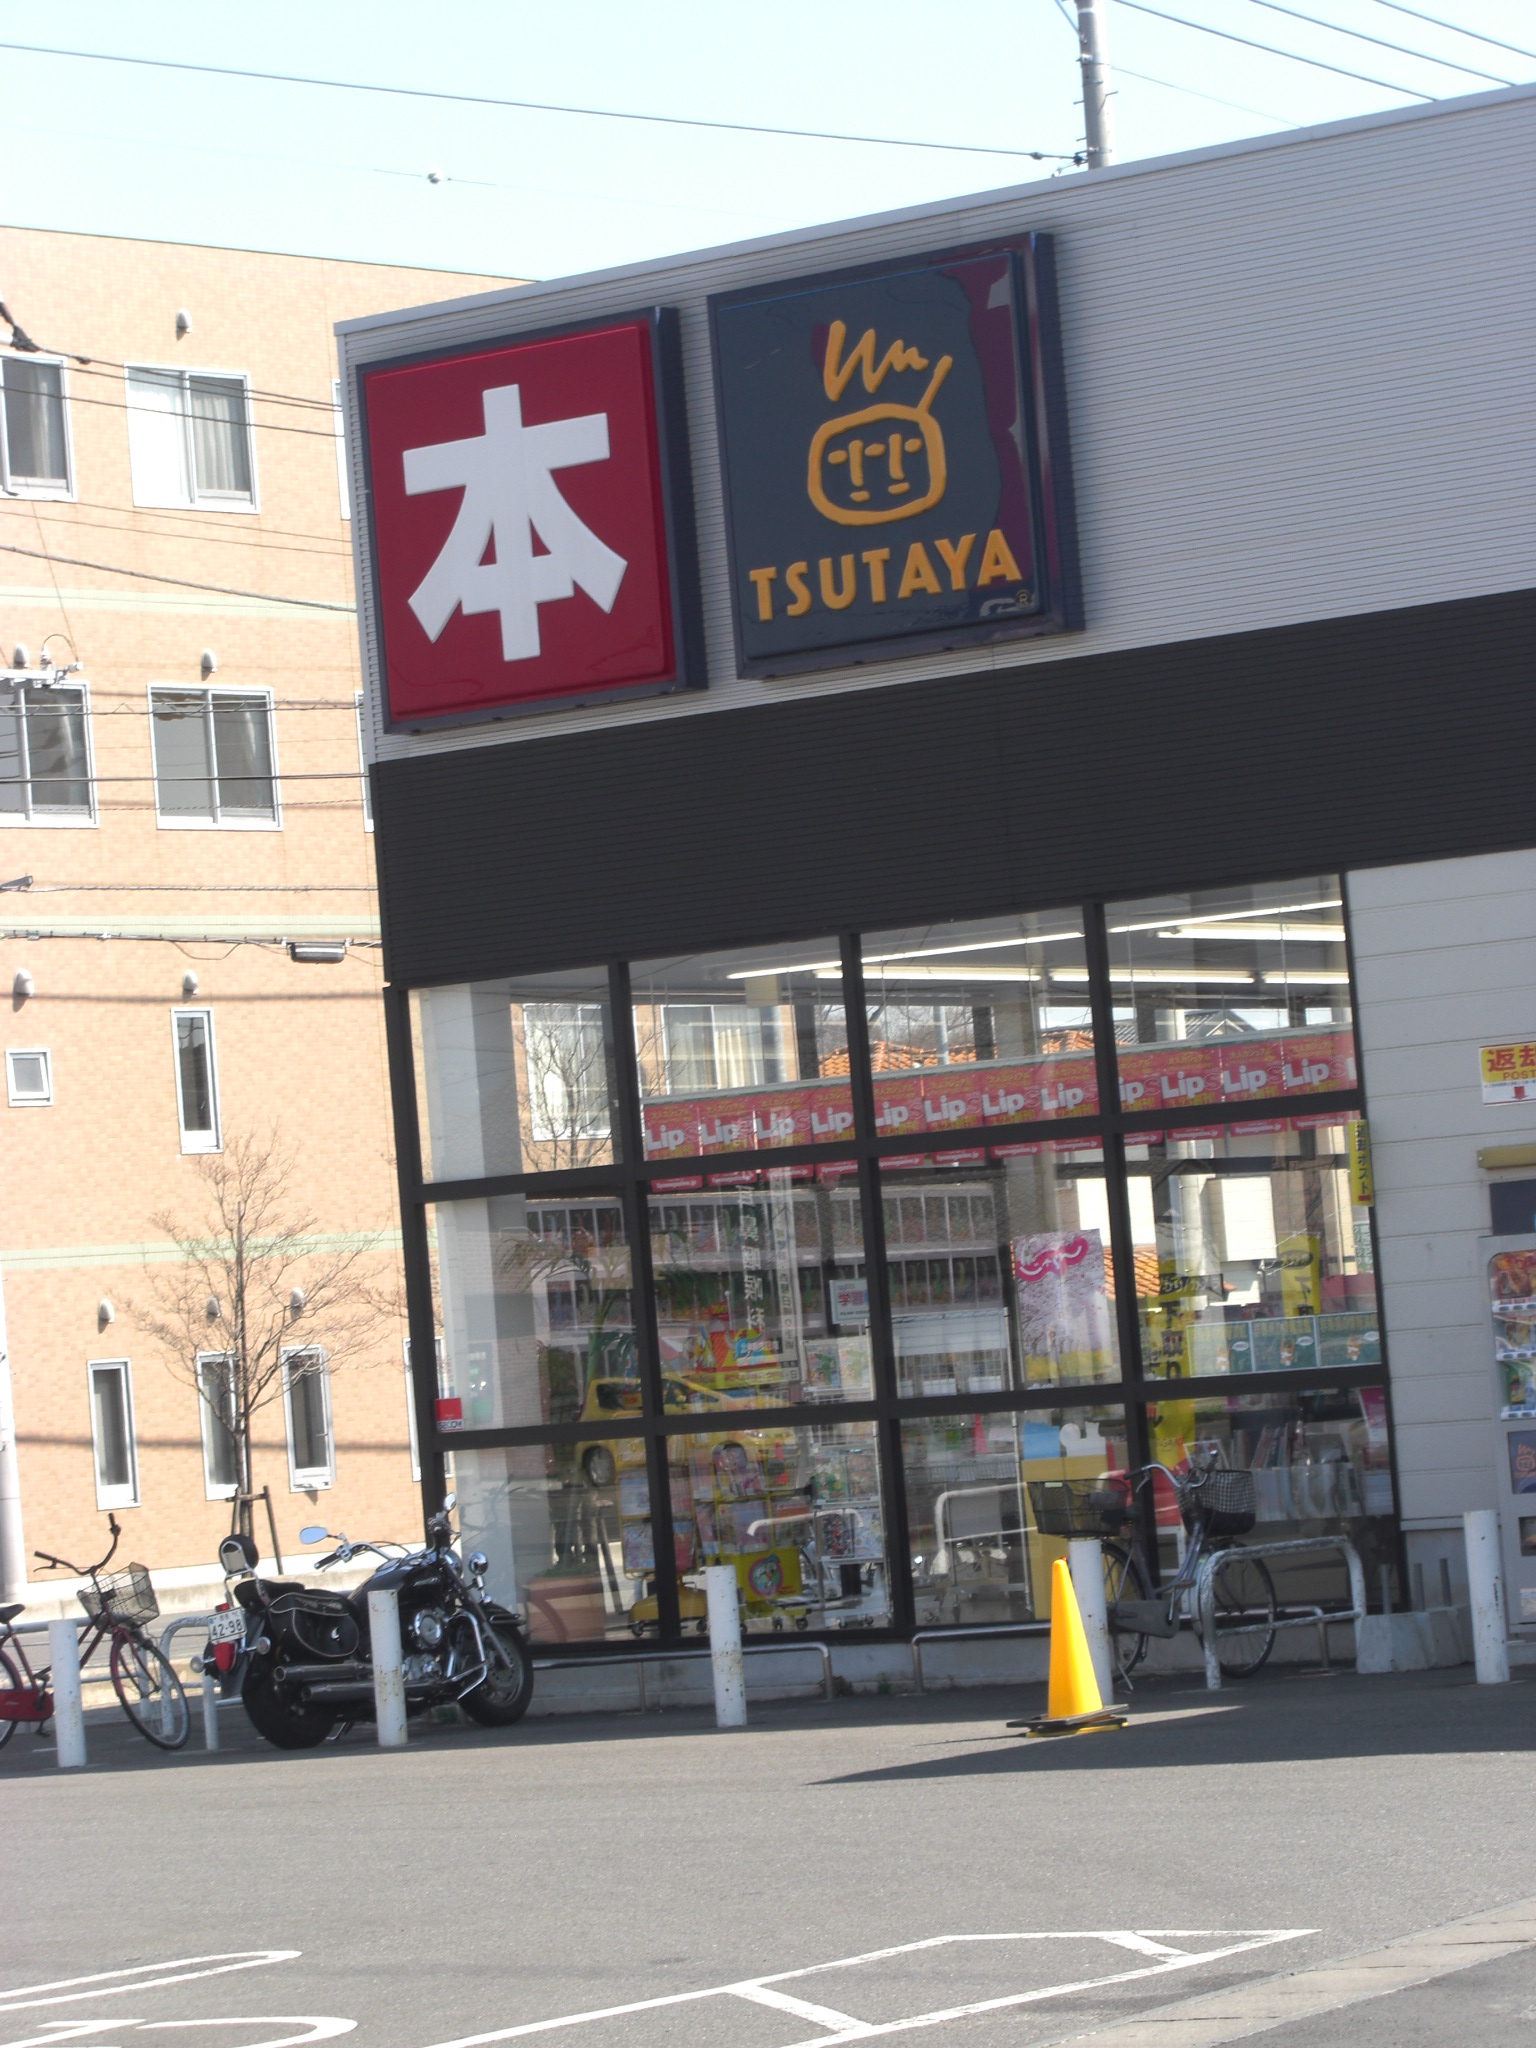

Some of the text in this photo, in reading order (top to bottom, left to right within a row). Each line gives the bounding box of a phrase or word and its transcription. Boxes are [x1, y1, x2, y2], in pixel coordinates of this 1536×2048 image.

[402, 383, 628, 662] 本
[749, 528, 1023, 622] TSUTAYA
[1502, 1069, 1536, 1081] POST
[212, 1618, 242, 1637] 42-98
